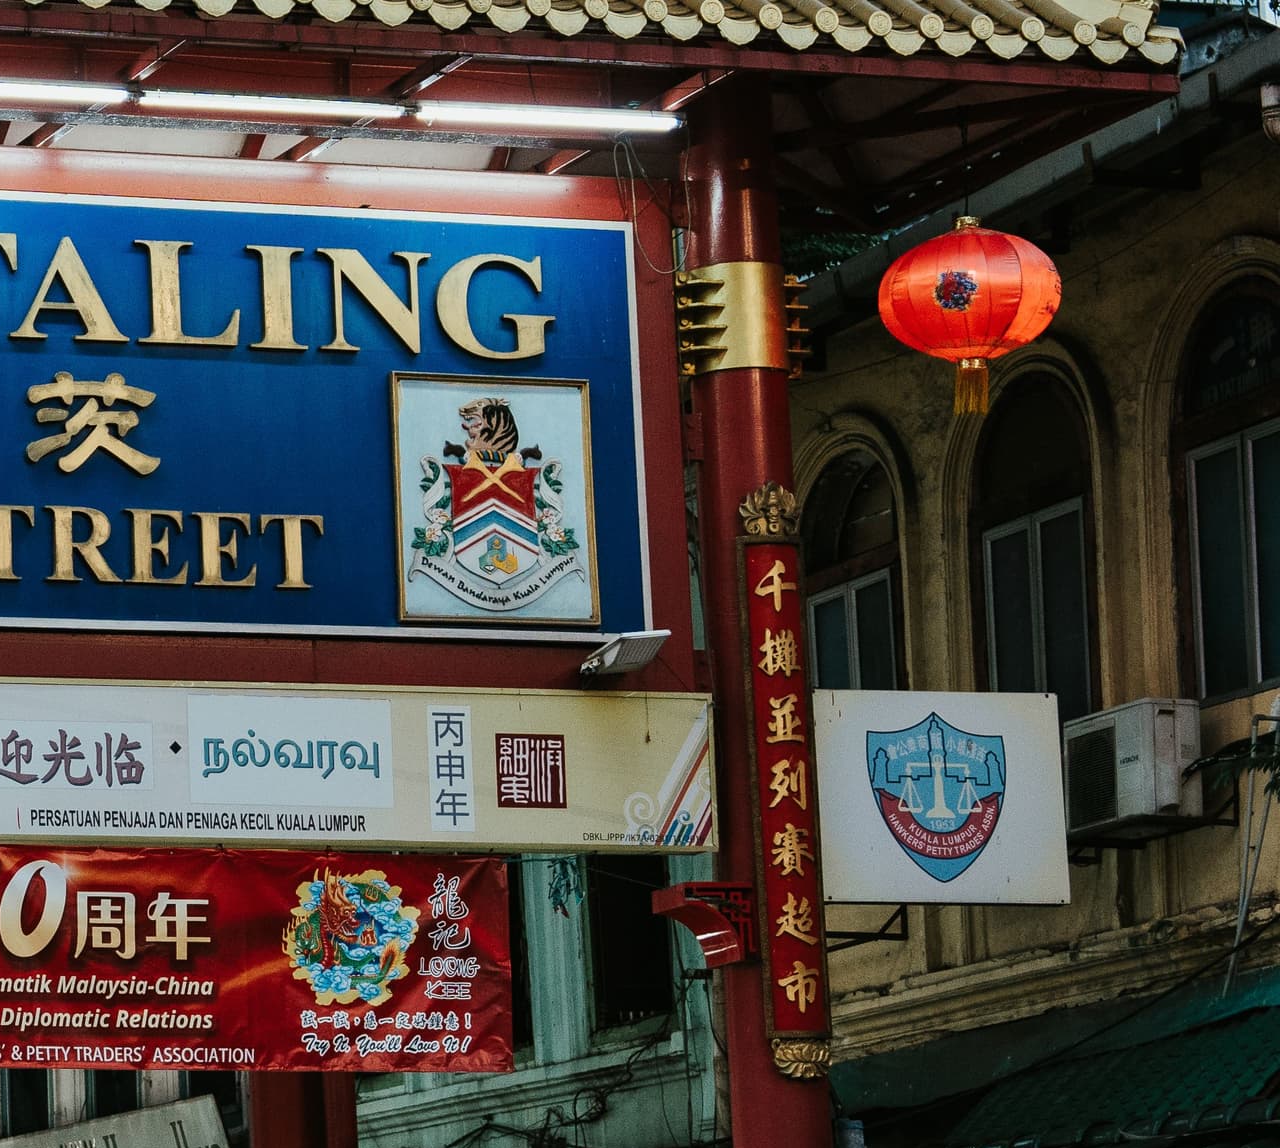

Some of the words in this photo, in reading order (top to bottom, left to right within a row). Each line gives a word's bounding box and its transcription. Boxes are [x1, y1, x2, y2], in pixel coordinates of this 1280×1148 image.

[421, 556, 456, 584] Dewan
[457, 580, 512, 606] Bandaraya
[513, 583, 541, 601] Kuala
[539, 555, 576, 585] Lumpur
[201, 728, 381, 779] நல்வரவு
[431, 711, 471, 828] 丙申年
[30, 810, 100, 828] PERSATUAN
[103, 811, 157, 830] PENJAJA
[159, 811, 185, 830] DAN
[186, 812, 238, 831] PENIAGA
[240, 812, 275, 831] KECIL
[276, 813, 316, 831] KUALA
[317, 814, 367, 833] LUMPUR
[908, 822, 940, 846] KUALA
[942, 823, 978, 846] LUMPUR
[926, 844, 955, 856] PETTY
[418, 957, 481, 978] LOONG
[57, 974, 215, 1000] Malaysia-China
[424, 981, 473, 1000] KEE
[0, 1007, 111, 1032] Diplomatic
[116, 1008, 214, 1030] Relations
[11, 1045, 24, 1062] &
[27, 1045, 71, 1062] PETTY
[153, 1046, 256, 1064] ASSOCIATION
[301, 1033, 330, 1056] Try
[404, 1035, 440, 1053] Love
